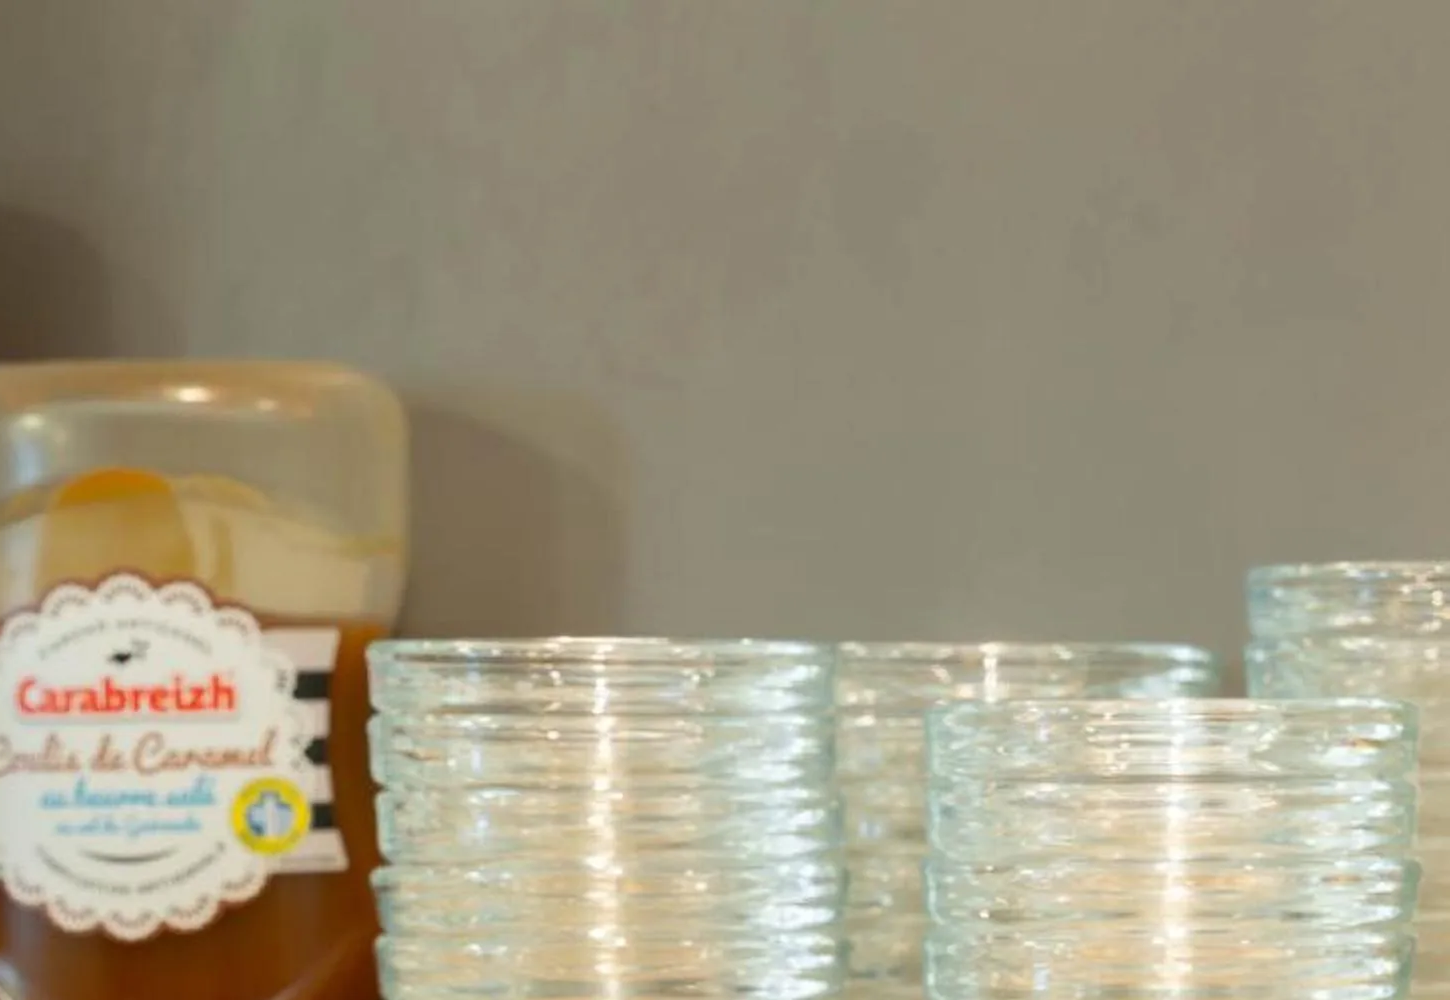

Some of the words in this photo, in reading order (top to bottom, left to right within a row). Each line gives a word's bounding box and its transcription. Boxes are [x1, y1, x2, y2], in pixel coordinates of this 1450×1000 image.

[17, 673, 238, 714] Carabreizh
[89, 732, 123, 773] de
[132, 728, 278, 777] Caramel
